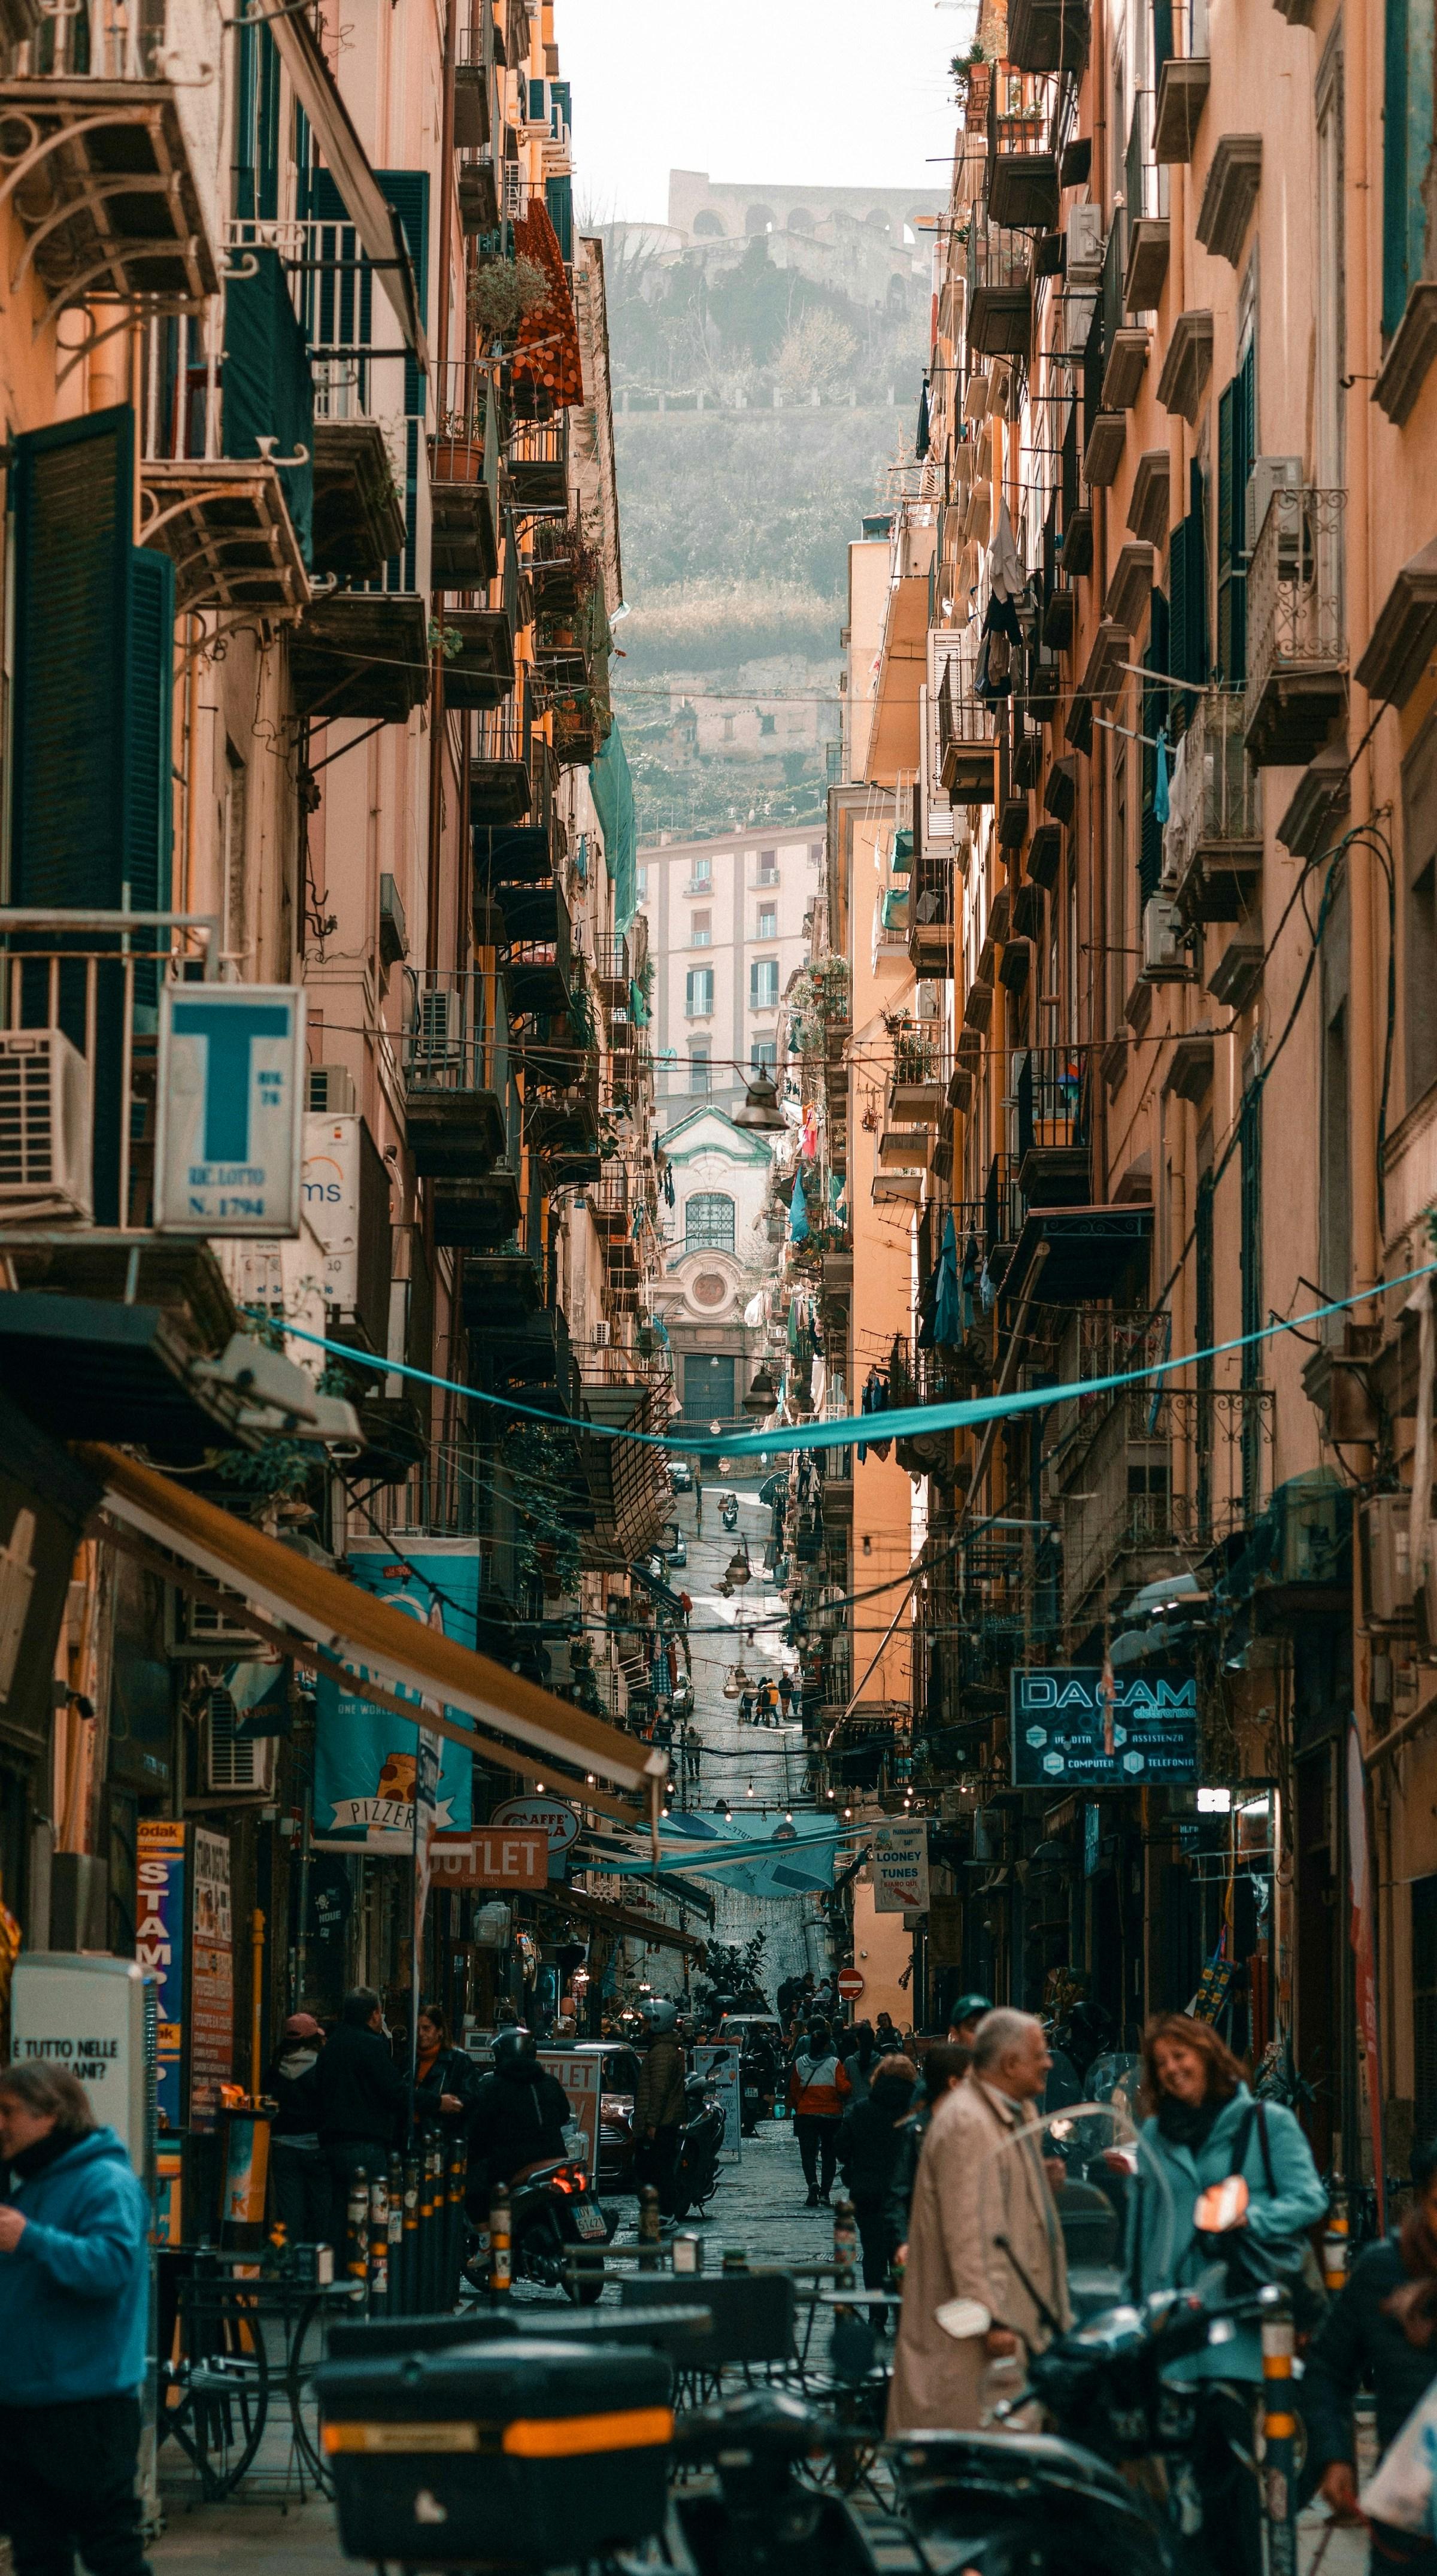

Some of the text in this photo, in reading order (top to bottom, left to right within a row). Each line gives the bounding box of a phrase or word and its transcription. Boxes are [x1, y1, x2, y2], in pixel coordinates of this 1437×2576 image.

[172, 1004, 289, 1163] T
[338, 1704, 356, 1715] ONE
[1133, 1705, 1196, 1719] elettronica
[1055, 1736, 1092, 1744] VEDITA
[1068, 1759, 1114, 1768] COMPUTER
[1148, 1758, 1195, 1766] TELEFONIA
[351, 1801, 415, 1829] PIZZER
[137, 1825, 177, 1838] odak
[431, 1841, 540, 1875] UTLET
[877, 1851, 921, 1862] LOONEY
[881, 1868, 918, 1878] TUNES
[25, 2040, 72, 2058] TUTTO
[78, 2040, 117, 2058] NELLE
